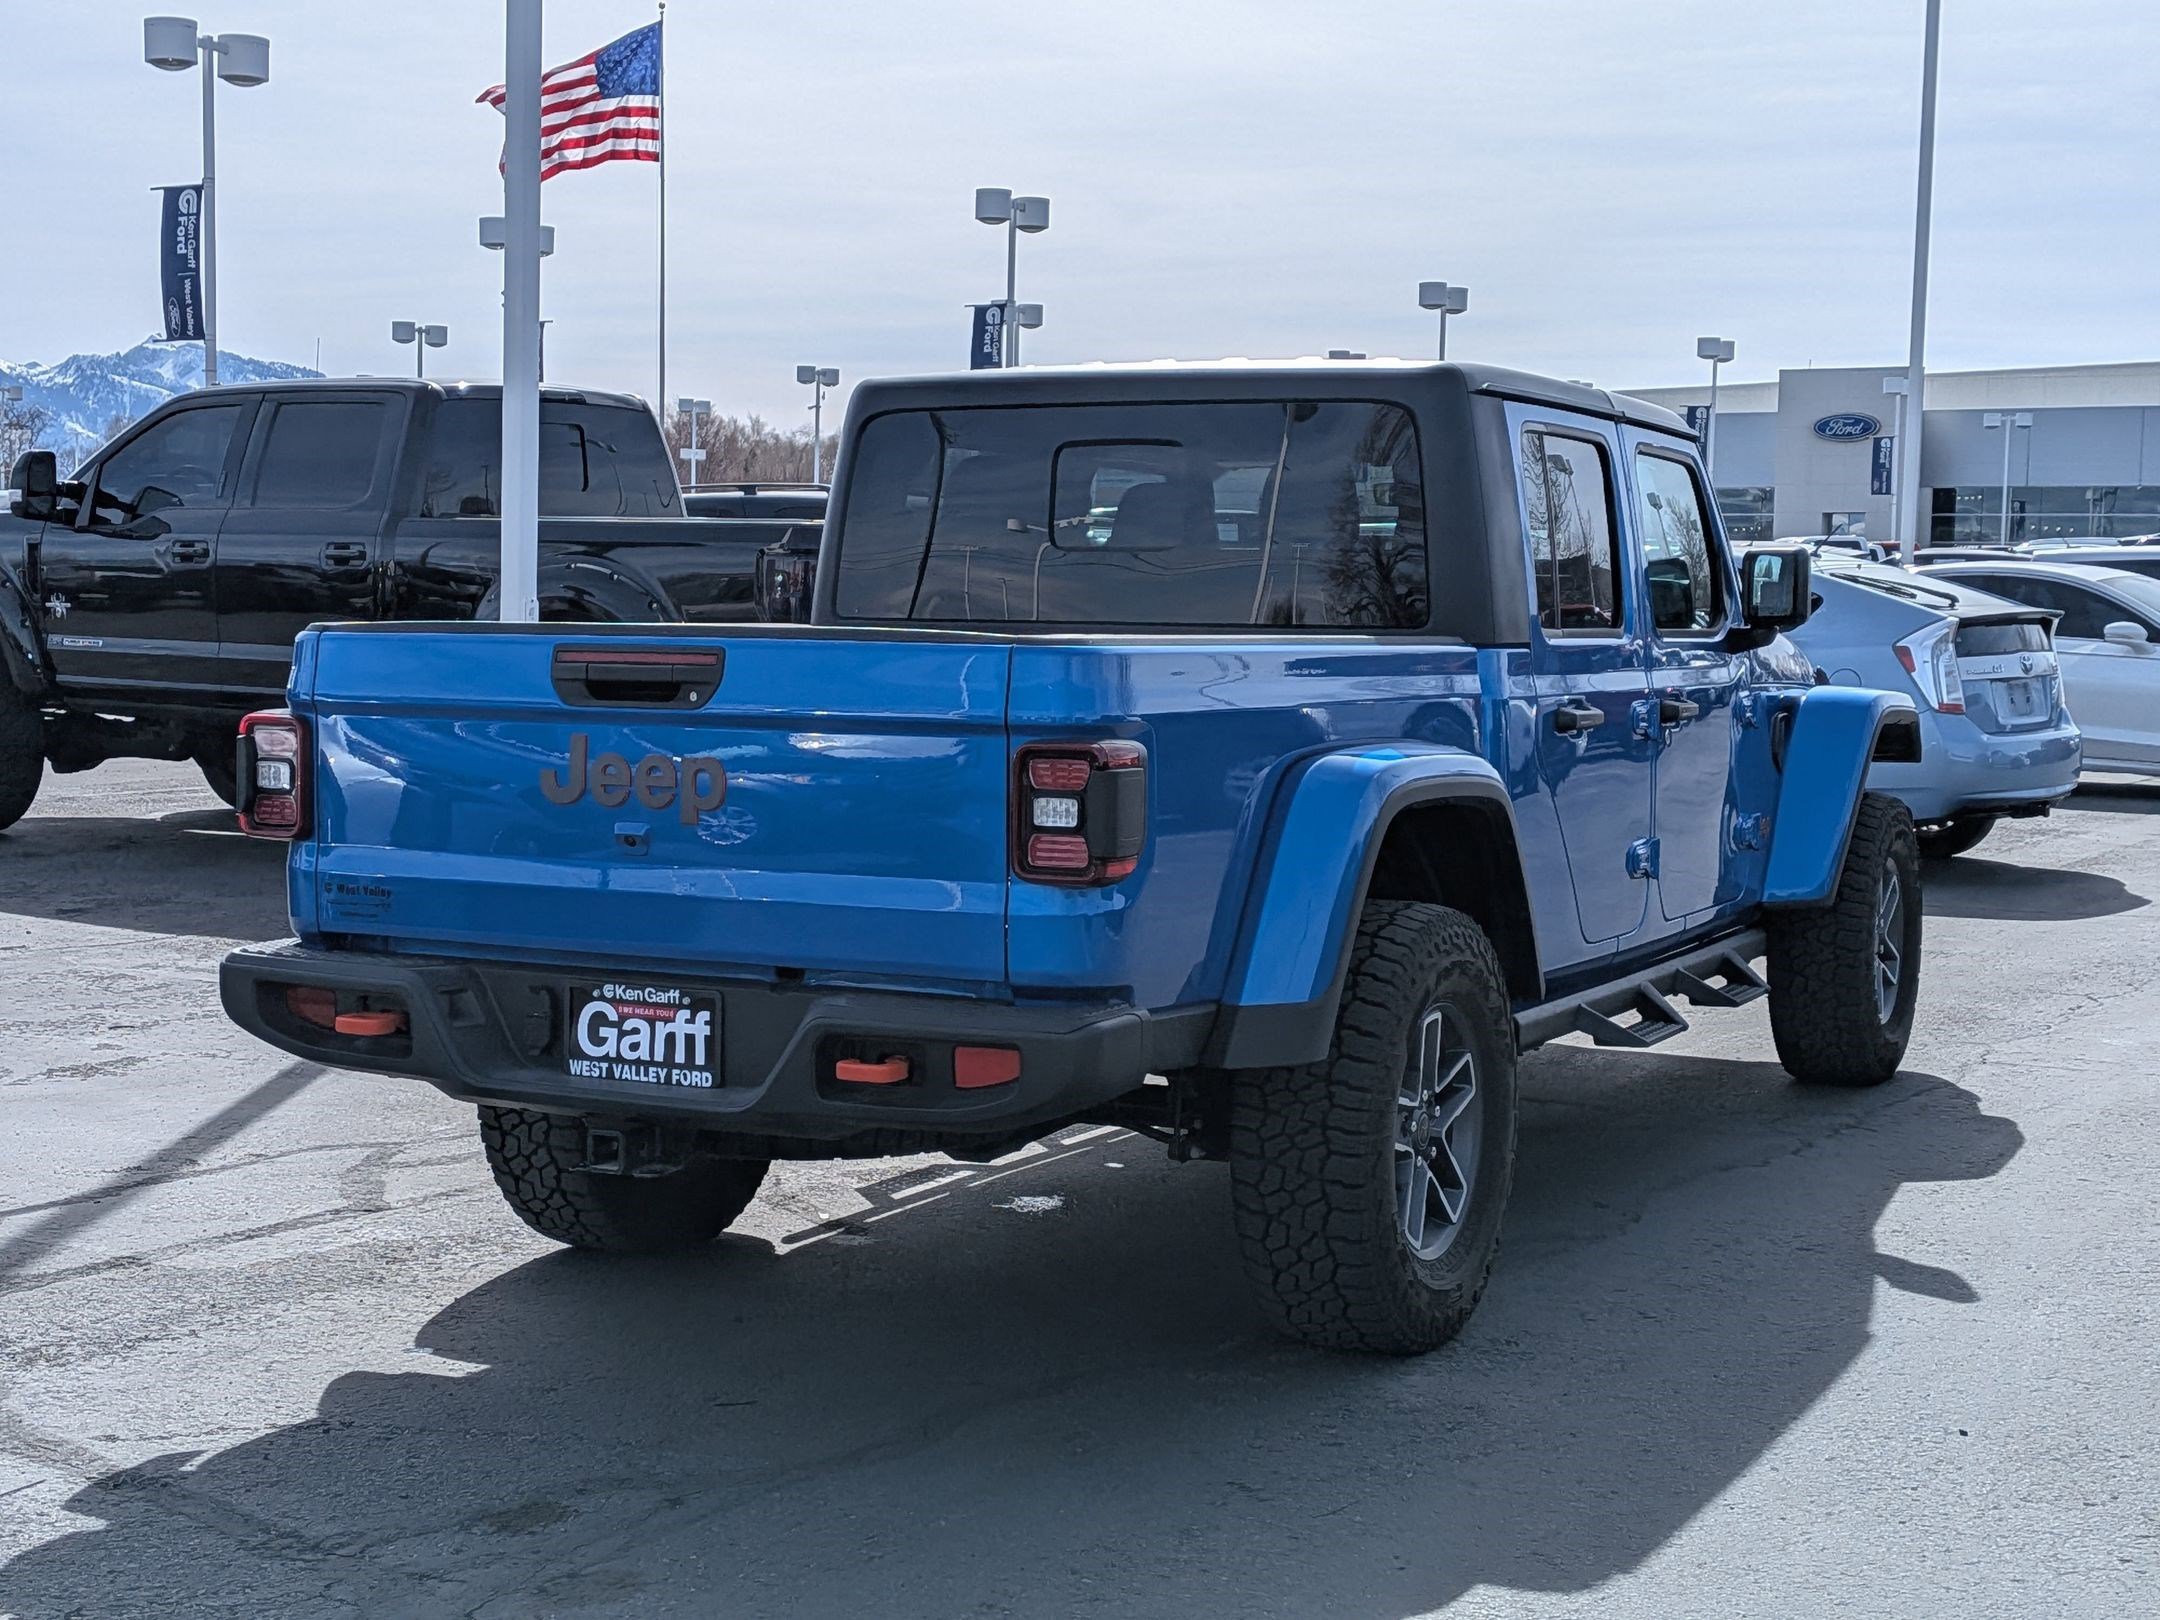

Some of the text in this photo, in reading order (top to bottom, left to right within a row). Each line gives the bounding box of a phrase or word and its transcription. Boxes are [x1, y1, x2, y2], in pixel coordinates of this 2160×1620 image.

[176, 216, 188, 254] Ford
[187, 215, 197, 268] Ken Garff
[184, 278, 195, 337] West Valley
[983, 325, 994, 352] Ford
[1825, 418, 1864, 435] Ford
[539, 733, 727, 825] Jeep
[615, 984, 643, 1001] Ken
[644, 987, 681, 1004] Garff
[623, 1006, 670, 1017] WE HEAR YOU
[577, 1000, 711, 1065] Garff
[569, 1059, 712, 1087] WEST VALLEY FORD
